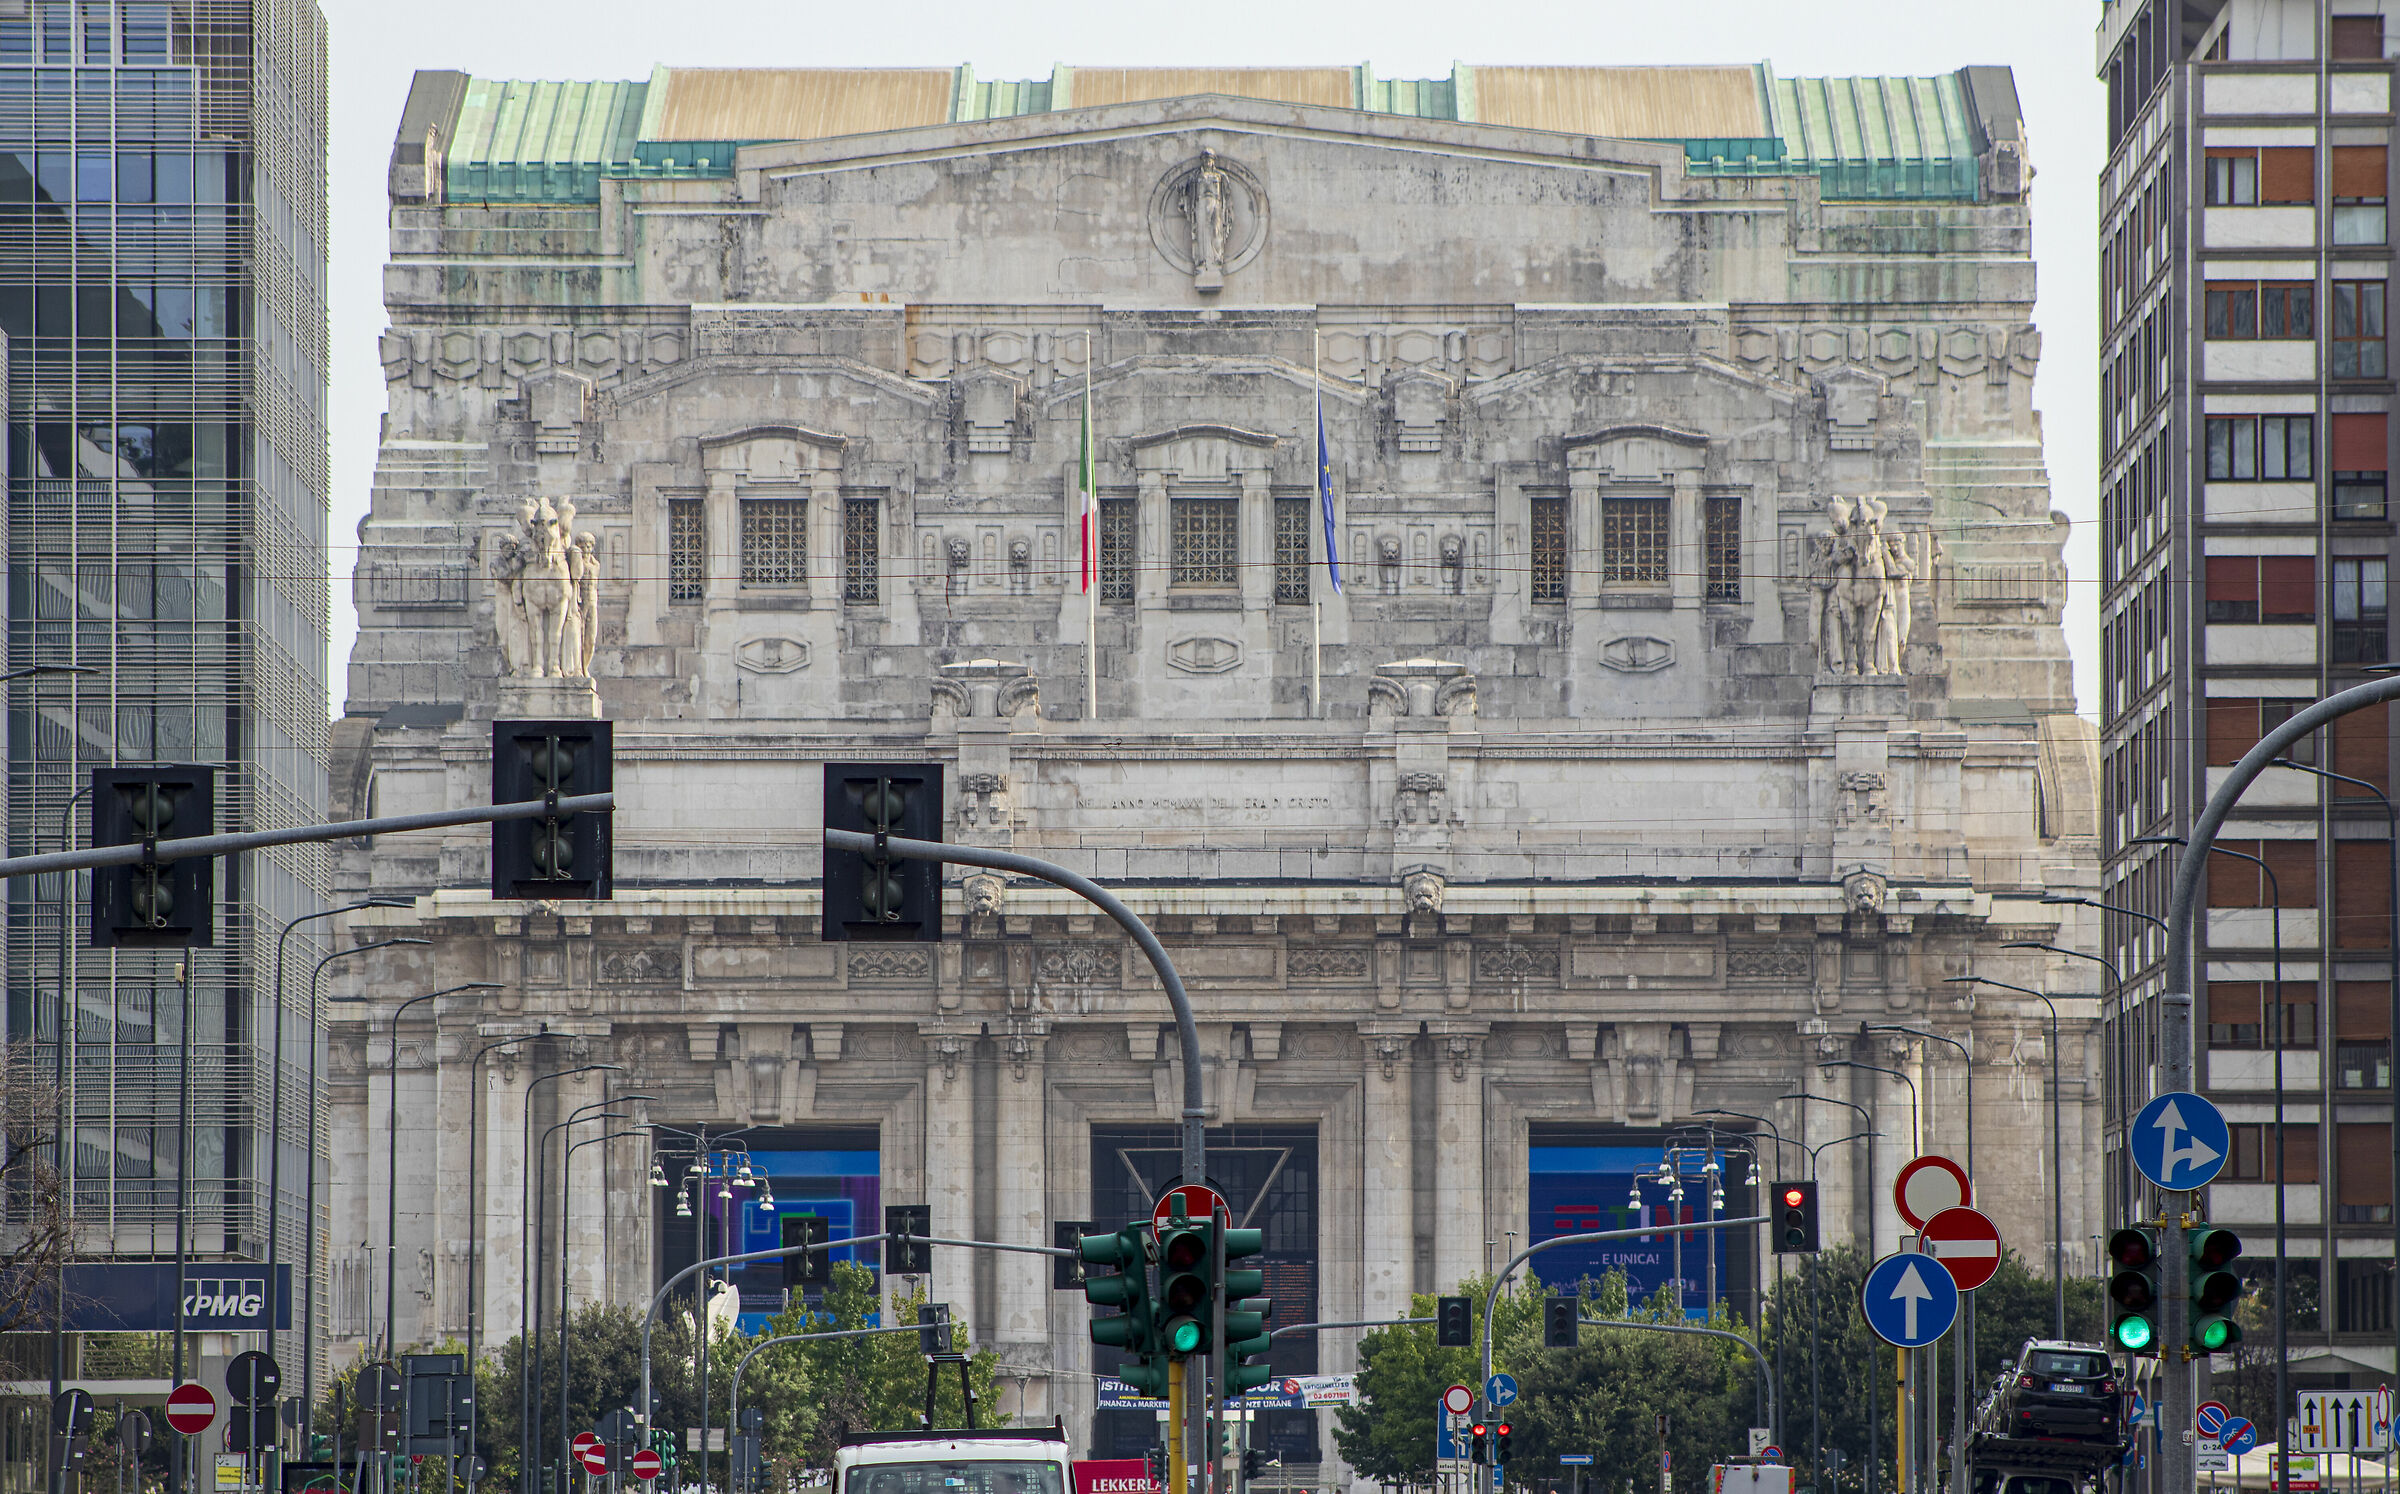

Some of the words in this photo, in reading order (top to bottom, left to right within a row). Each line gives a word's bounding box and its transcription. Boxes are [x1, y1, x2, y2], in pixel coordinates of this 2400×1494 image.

[1112, 799, 1144, 809] ANNO
[1608, 1205, 1694, 1243] TIM
[1602, 1253, 1610, 1265] E
[1614, 1253, 1660, 1265] UNICA!
[1100, 1399, 1132, 1408] FINANZA
[1138, 1400, 1170, 1409] MARKETI
[1263, 1399, 1292, 1408] UMANE
[1092, 1478, 1170, 1492] LEKKERLA
